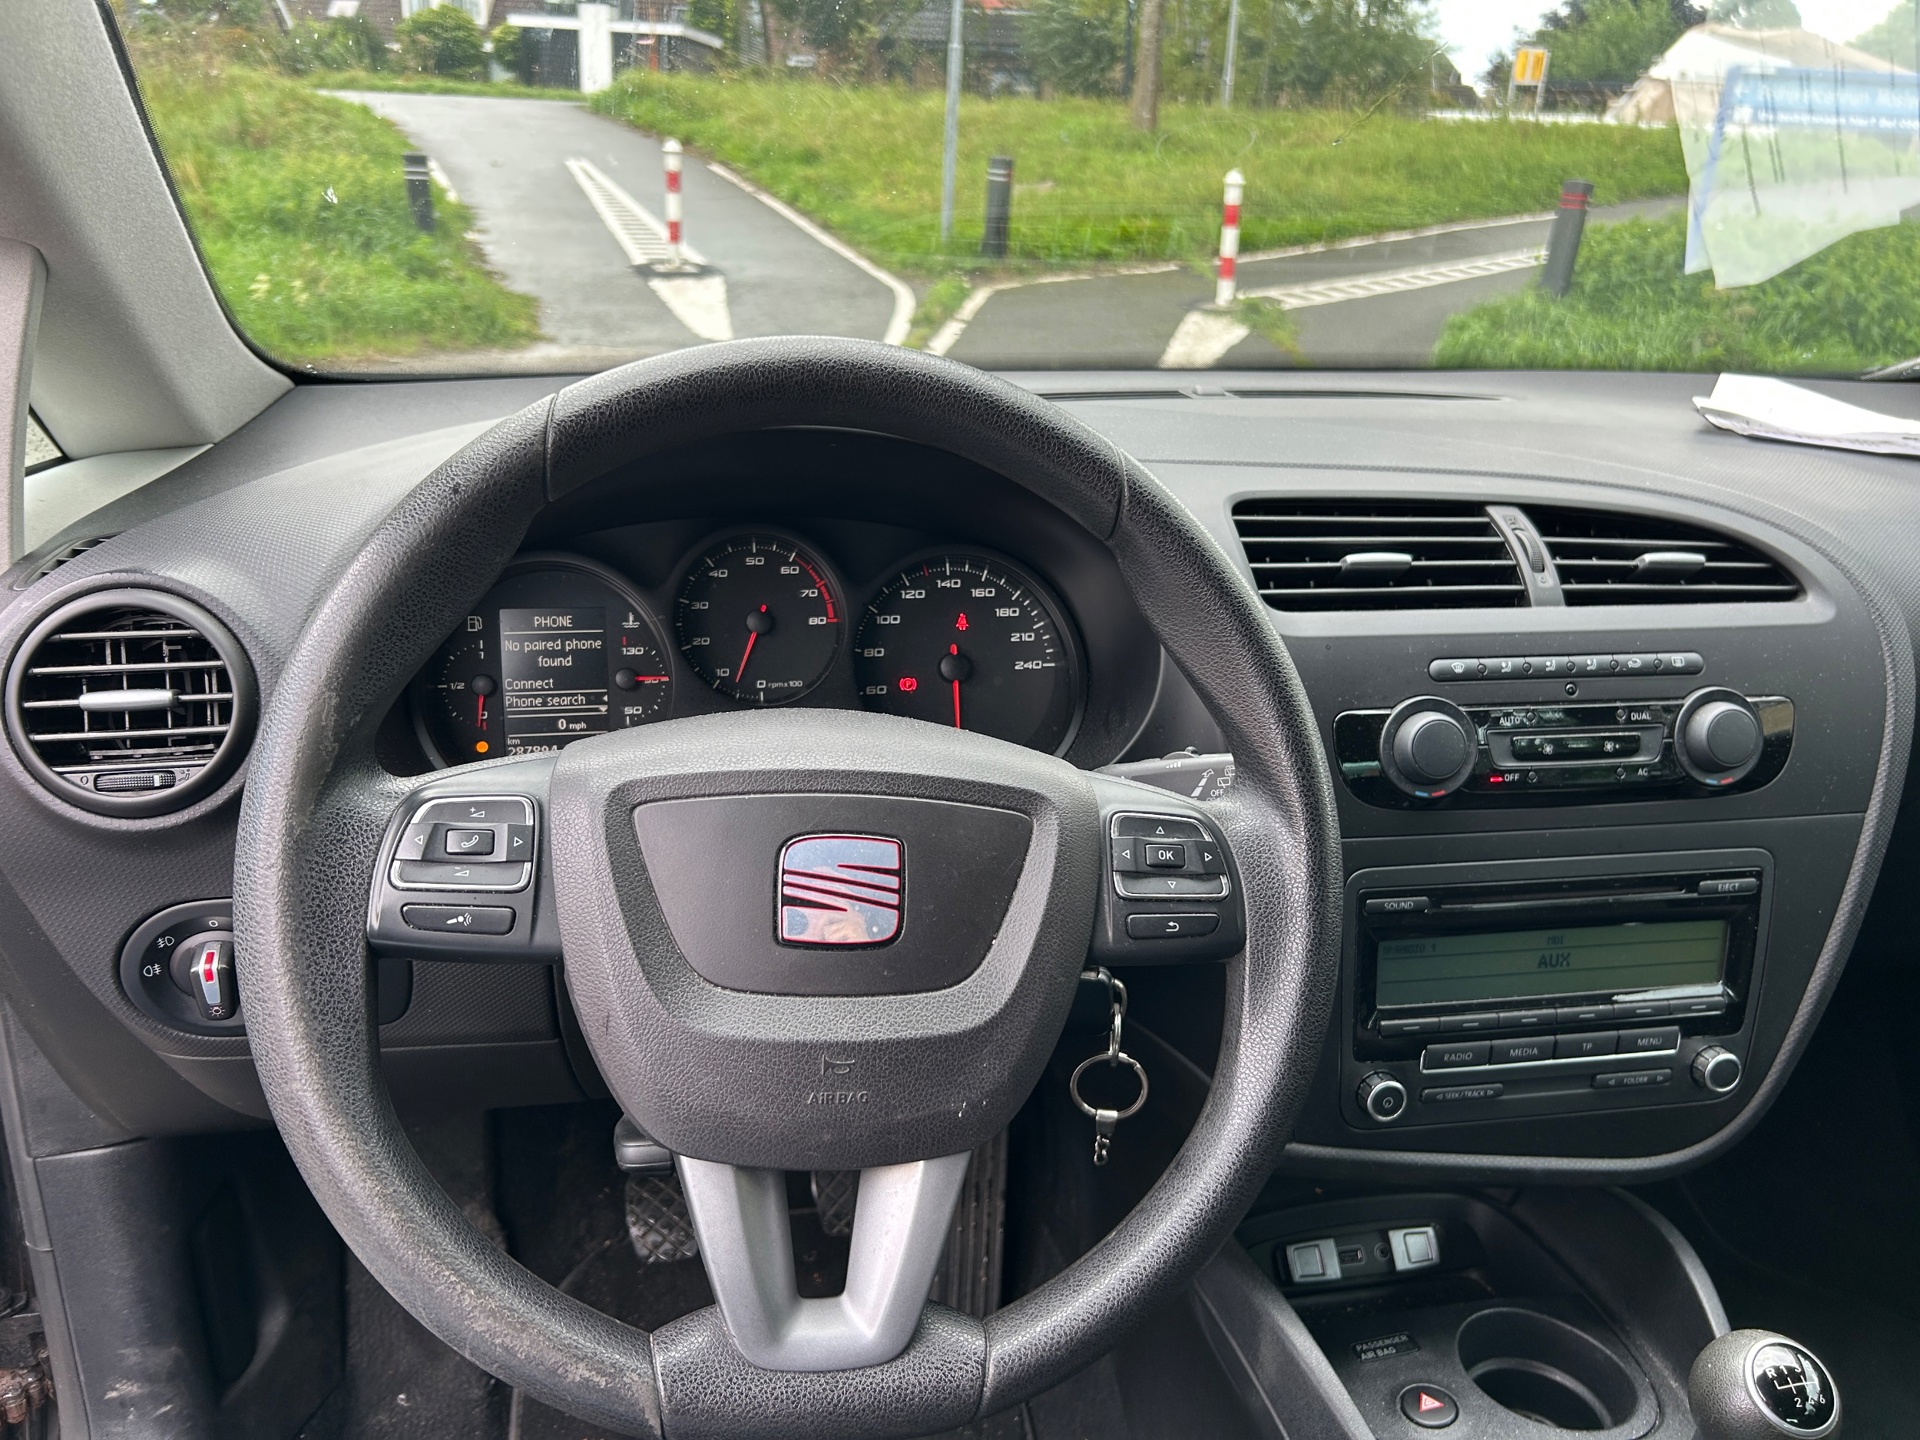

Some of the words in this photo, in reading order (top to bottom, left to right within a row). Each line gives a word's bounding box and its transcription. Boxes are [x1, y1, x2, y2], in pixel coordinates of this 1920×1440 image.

[746, 557, 764, 565] 50
[708, 570, 728, 578] 40
[780, 566, 800, 574] 60
[936, 579, 961, 588] 140
[800, 589, 818, 598] 70
[901, 590, 926, 599] 120
[970, 588, 996, 598] 160
[691, 602, 708, 610] 30
[994, 608, 1020, 617] 180
[534, 616, 573, 628] PHONE
[808, 616, 826, 625] 80
[876, 615, 900, 624] 100
[1010, 632, 1035, 642] 210
[505, 640, 520, 652] No
[524, 639, 562, 654] paired
[566, 638, 602, 652] phone
[692, 638, 710, 646] 20
[622, 647, 644, 656] 130
[864, 648, 884, 657] 80
[538, 656, 572, 668] found
[1014, 660, 1042, 670] 240
[716, 668, 730, 676] 10
[450, 682, 465, 690] 1/2
[505, 678, 554, 690] Connect
[757, 680, 766, 688] 0
[866, 686, 888, 694] 60
[506, 695, 543, 707] Phone
[547, 694, 586, 706] search
[624, 706, 642, 715] 50
[1630, 711, 1652, 721] DUAL
[558, 718, 566, 730] 0
[570, 721, 587, 730] mph
[1499, 716, 1521, 726] AUTO
[508, 738, 520, 746] km
[1504, 772, 1520, 782] OFF
[1637, 768, 1648, 777] AC
[1210, 788, 1224, 798] OFF
[1158, 850, 1174, 861] OK
[1718, 882, 1740, 892] EJECT
[1384, 901, 1414, 912] SOUND
[1537, 952, 1572, 969] AUX
[1637, 1037, 1662, 1046] MENU
[1582, 1042, 1592, 1051] TP
[1444, 1052, 1473, 1062] RADIO
[1509, 1048, 1538, 1058] MEDIA
[1623, 1076, 1648, 1084] FOLDER
[1765, 1368, 1777, 1378] R
[1794, 1398, 1802, 1408] 2
[1820, 1394, 1826, 1404] 6
